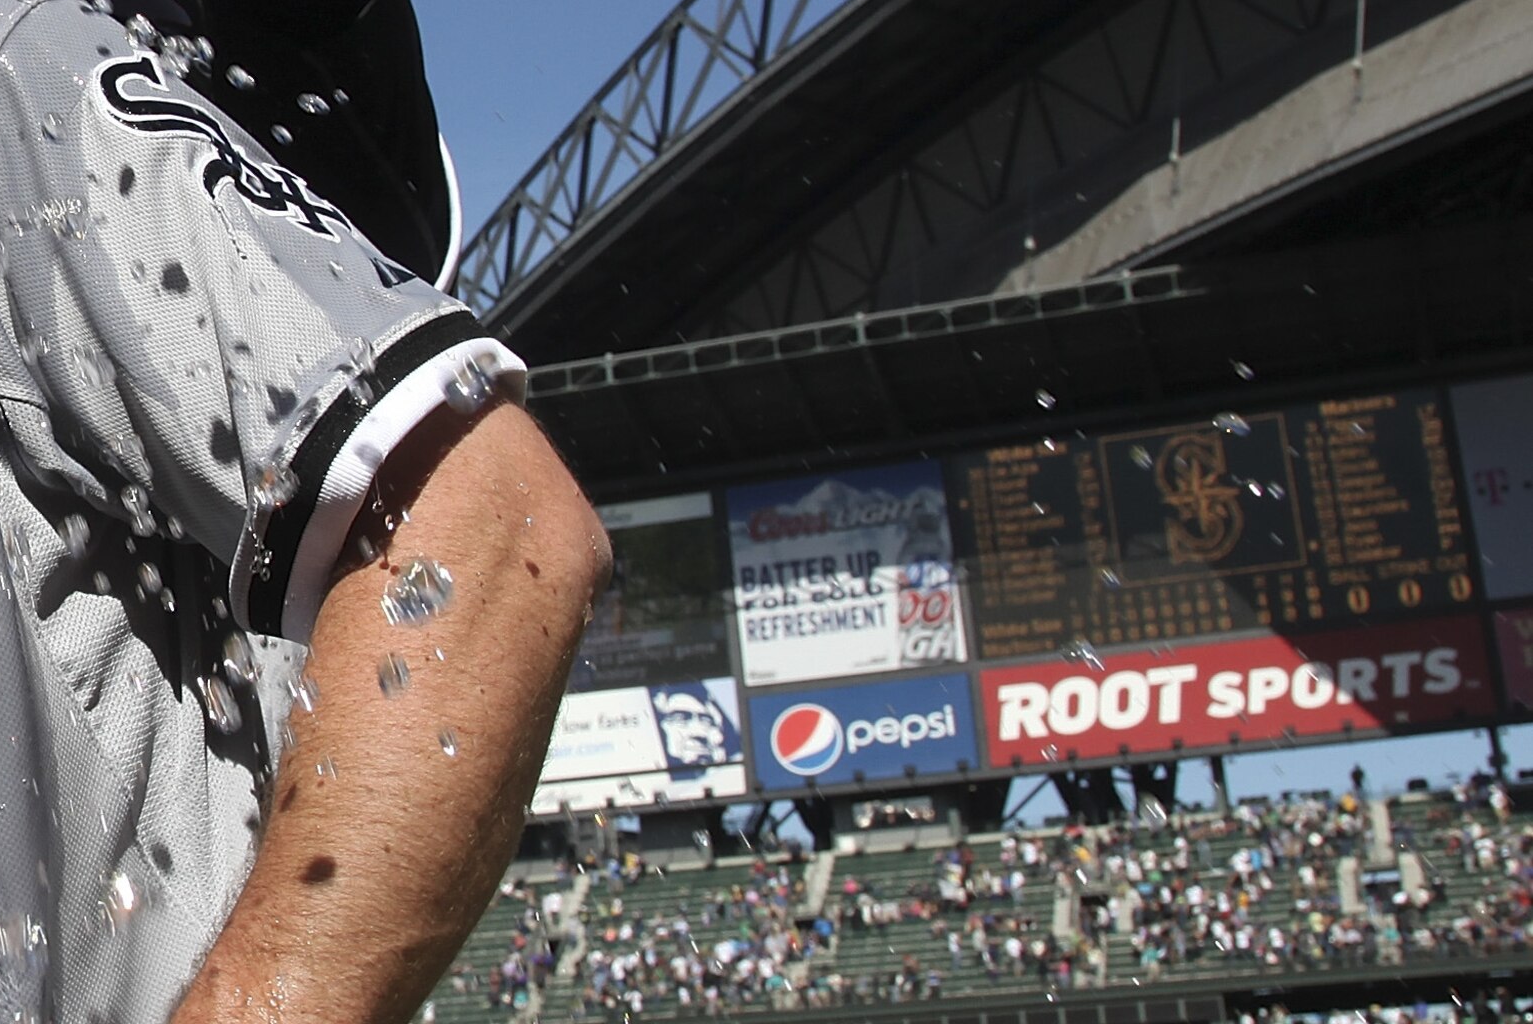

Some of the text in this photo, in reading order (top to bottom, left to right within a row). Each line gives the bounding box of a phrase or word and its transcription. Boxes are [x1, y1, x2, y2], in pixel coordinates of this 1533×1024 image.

[748, 508, 830, 542] Coors
[740, 549, 882, 593] BATTER UP
[1448, 573, 1472, 603] 0
[1347, 585, 1370, 614] 0
[1398, 579, 1422, 608] 0
[745, 602, 887, 642] REFRESHMENT
[998, 647, 1461, 741] ROOT SPORTS
[847, 705, 957, 754] pepsi
